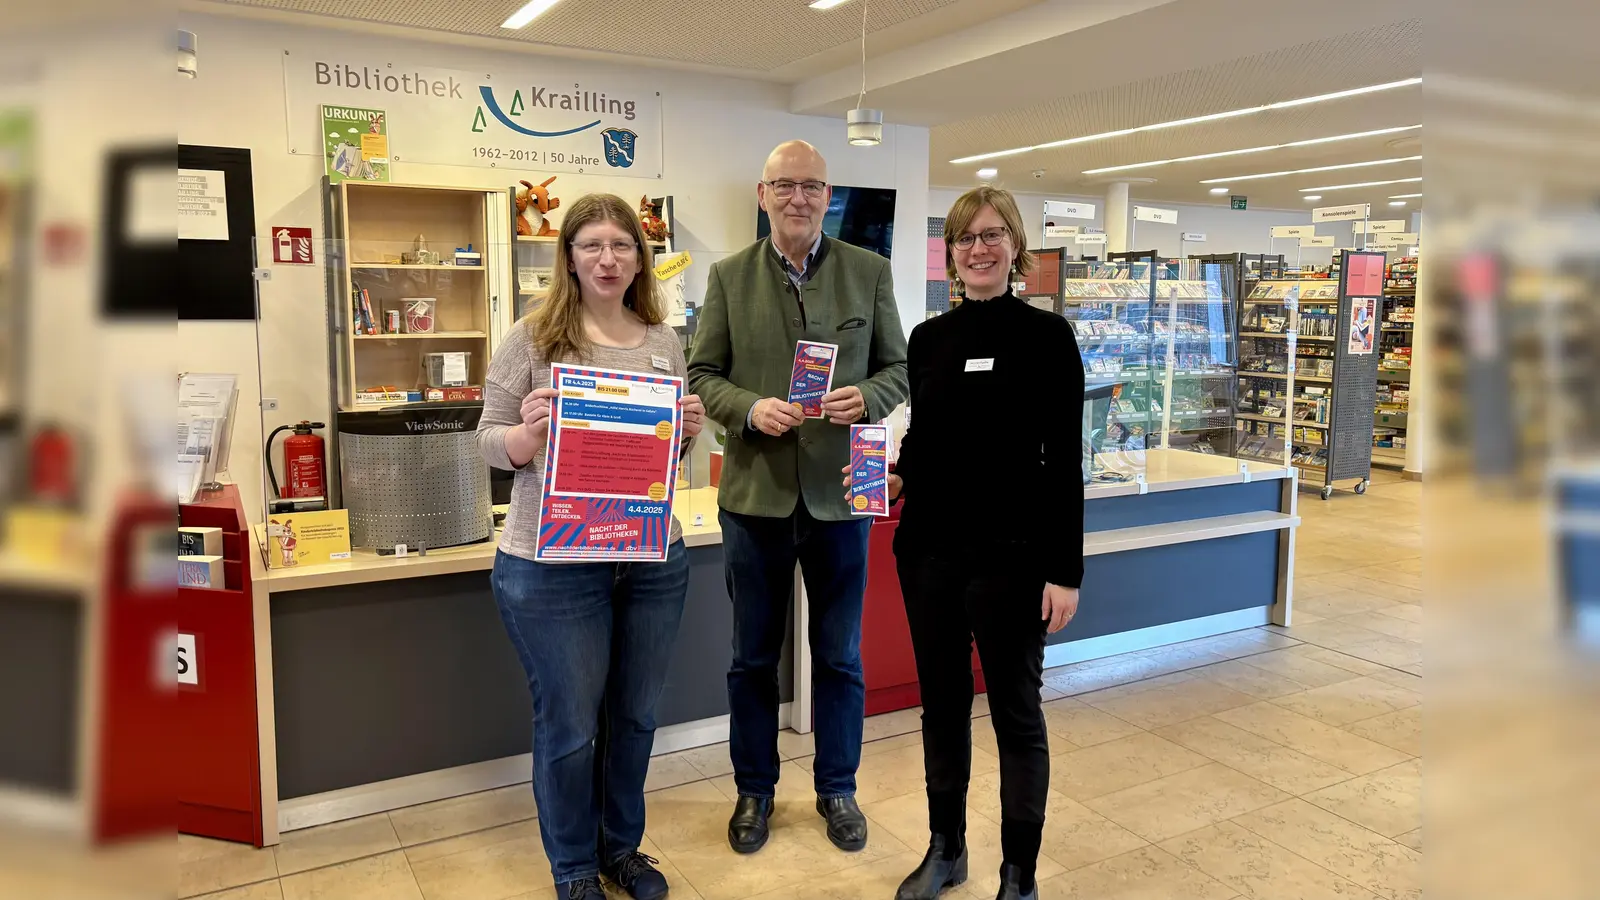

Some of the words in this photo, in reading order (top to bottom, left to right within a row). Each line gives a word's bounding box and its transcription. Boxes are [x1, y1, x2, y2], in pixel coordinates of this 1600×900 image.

[314, 62, 463, 100] Bibliothek
[531, 86, 636, 120] Krailling
[324, 107, 384, 122] URKUNDE
[550, 152, 565, 164] 50
[568, 154, 600, 166] Jahre
[1322, 210, 1356, 218] Konsolenspiele
[657, 264, 677, 277] Tasche
[807, 373, 824, 382] NACHT
[791, 390, 826, 400] BIBLIOTHEKEN
[405, 421, 464, 431] ViewSonic
[866, 460, 882, 468] NACHT
[853, 479, 885, 493] BIBLIOTHEKEN
[628, 506, 663, 514] 4.4.2025
[589, 525, 612, 534] NACHT
[182, 534, 194, 544] BIS
[590, 530, 638, 541] BIBLIOTHEKEN
